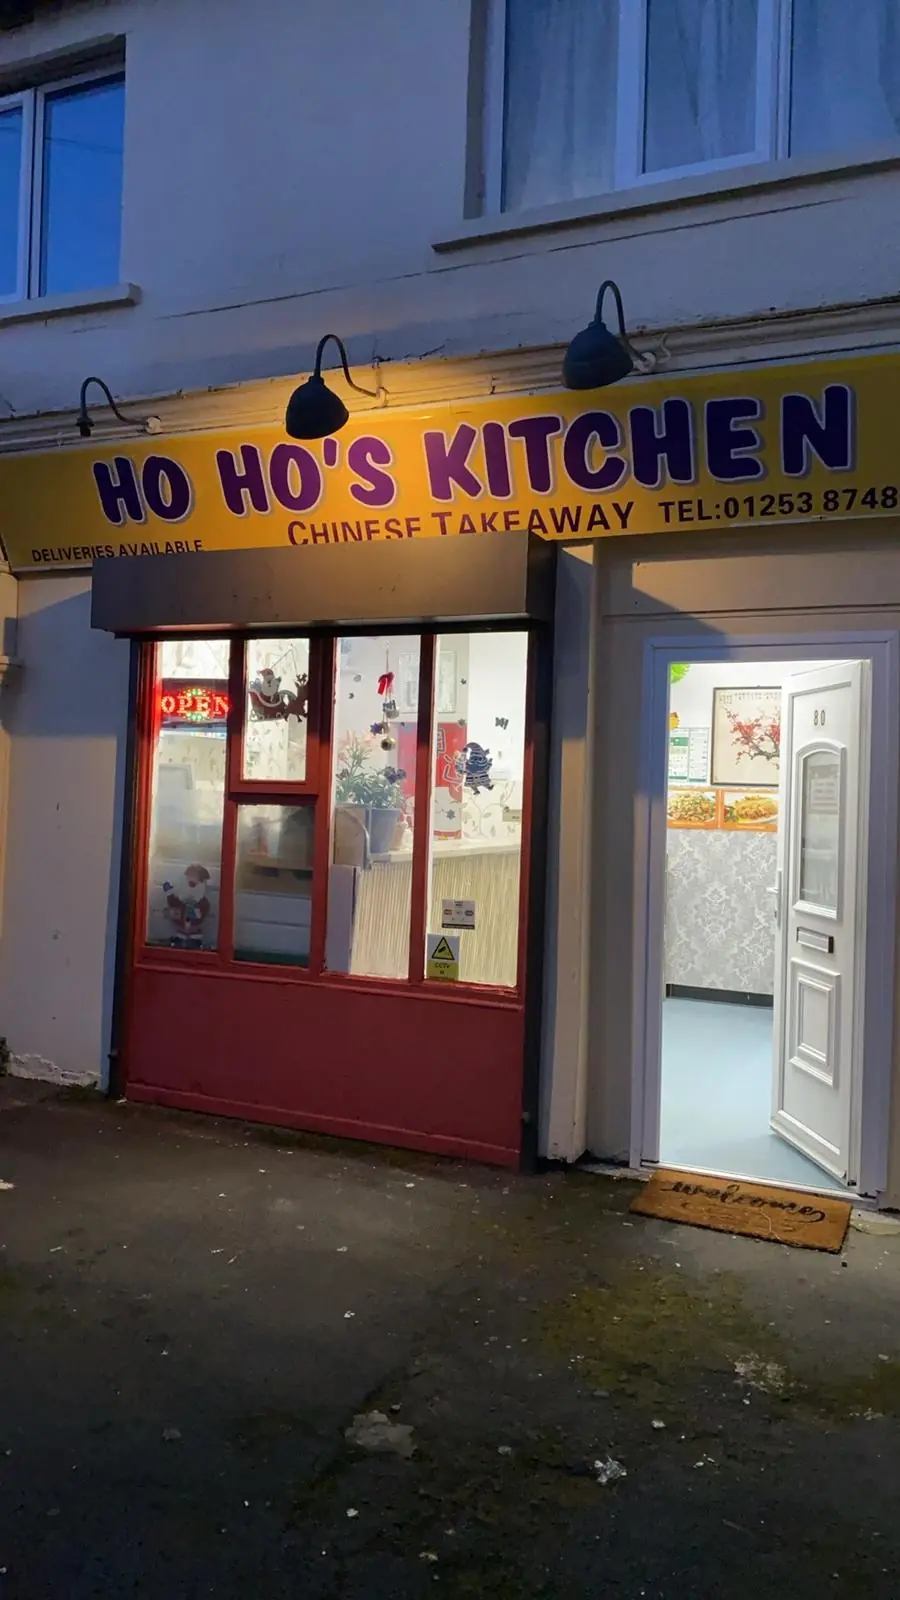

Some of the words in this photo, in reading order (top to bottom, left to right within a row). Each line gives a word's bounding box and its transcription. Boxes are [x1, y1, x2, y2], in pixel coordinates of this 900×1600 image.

[92, 455, 192, 525] HO
[215, 434, 397, 517] HO'S
[423, 383, 852, 503] KITCHEN
[287, 517, 421, 546] CHINESE
[431, 501, 634, 535] TAKEAWAY
[31, 543, 115, 562] DELIVERIES
[118, 539, 203, 557] AVAILABLE
[160, 694, 229, 715] OPEN
[813, 709, 826, 726] 80
